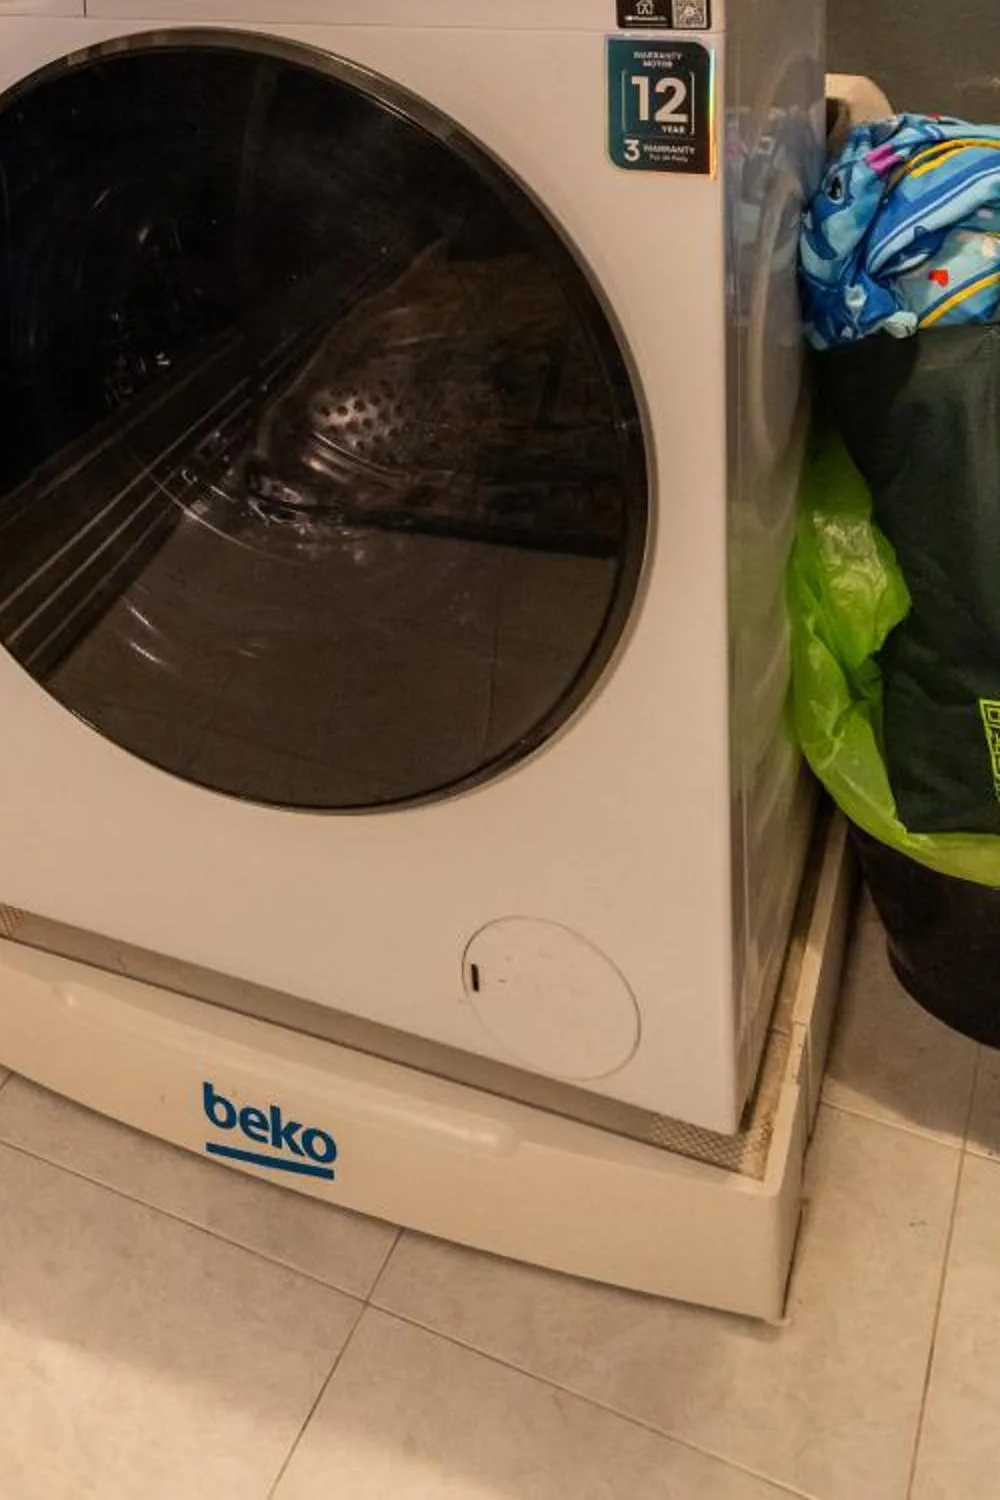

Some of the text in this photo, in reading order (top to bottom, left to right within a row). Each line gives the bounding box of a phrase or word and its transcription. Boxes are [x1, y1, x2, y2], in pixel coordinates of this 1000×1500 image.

[633, 51, 683, 60] WARRANTY
[631, 75, 689, 123] 12
[661, 124, 685, 134] YEAR
[624, 139, 640, 162] 3
[643, 143, 696, 155] WARRANTY
[203, 1081, 338, 1164] beko
